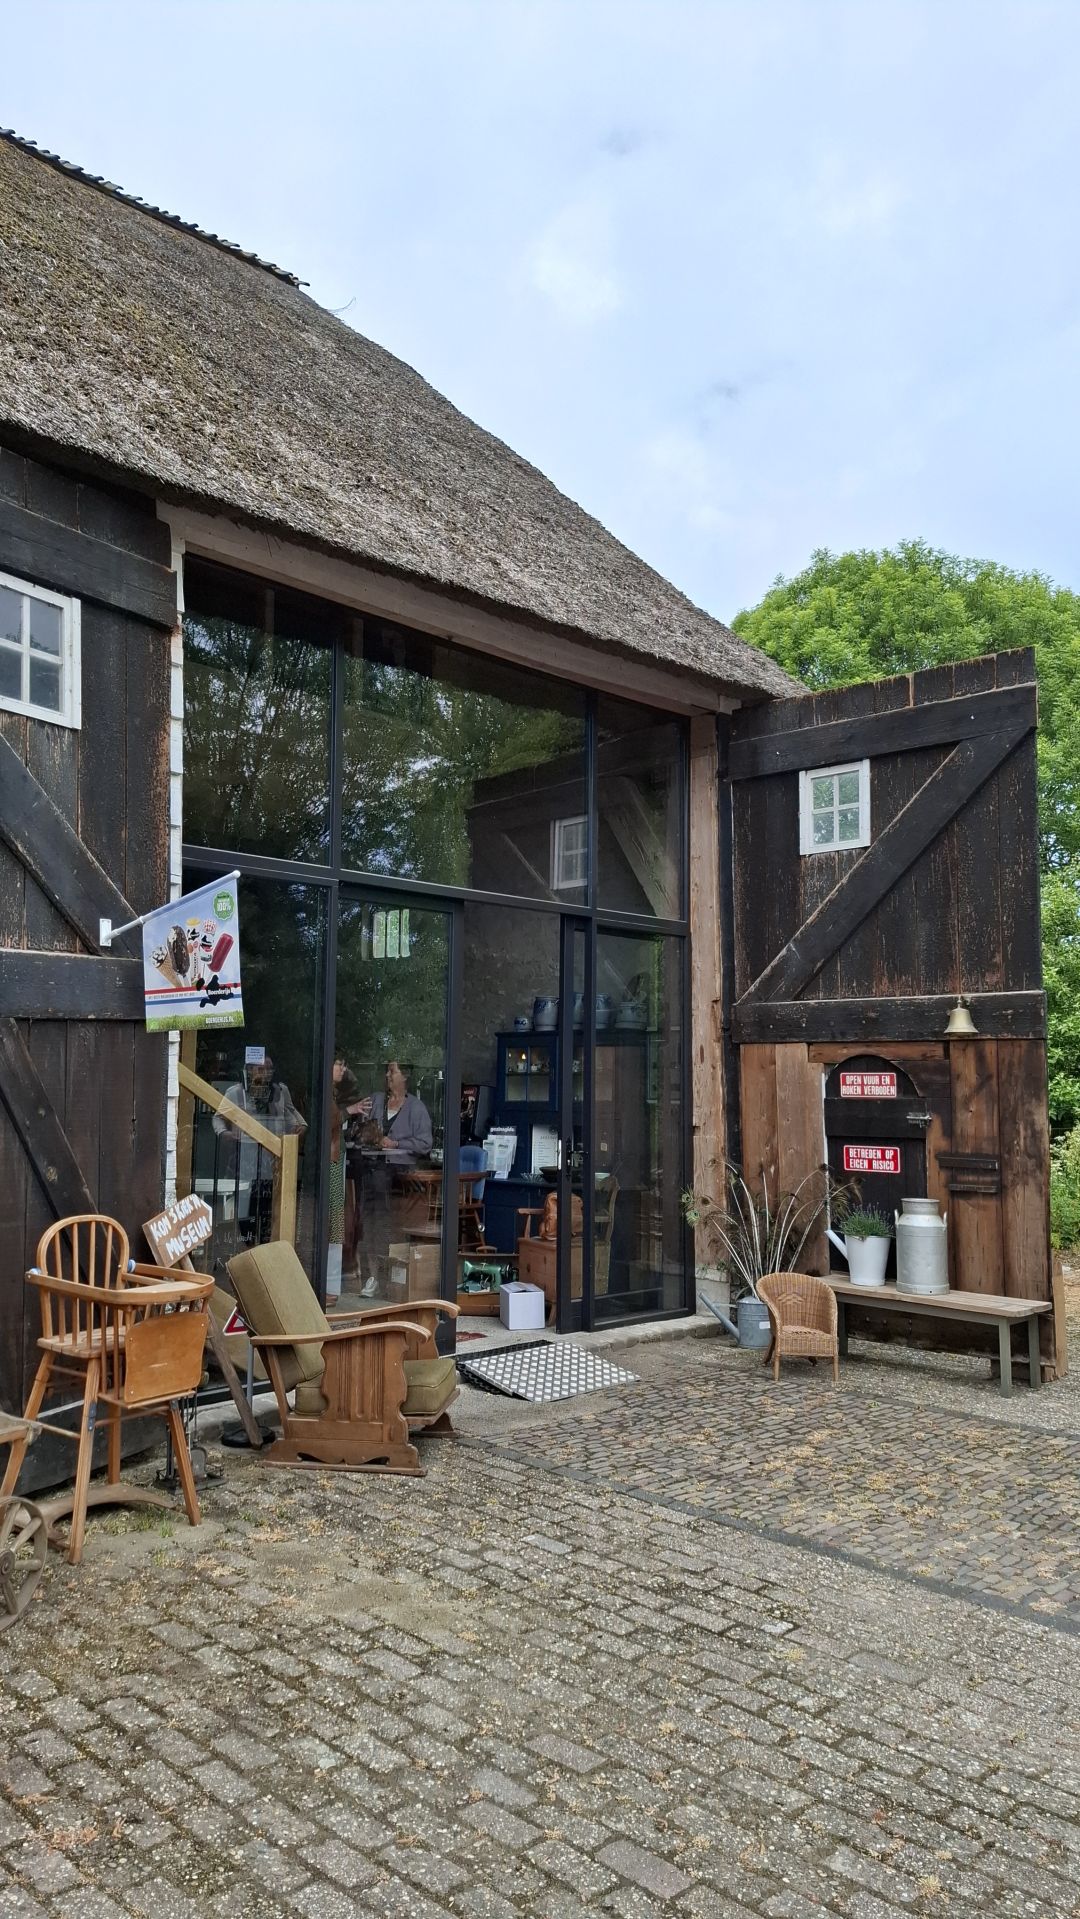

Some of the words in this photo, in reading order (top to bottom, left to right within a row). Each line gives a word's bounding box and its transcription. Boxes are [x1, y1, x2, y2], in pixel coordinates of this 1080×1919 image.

[845, 1075, 862, 1085] OPEN
[863, 1075, 880, 1085] VUUR
[881, 1075, 891, 1085] EN
[842, 1085, 862, 1095] ROKEN
[863, 1085, 895, 1096] VERBODEN
[849, 1148, 882, 1160] BETREDEN
[885, 1149, 894, 1160] OP
[849, 1159, 869, 1169] EIGEN
[872, 1160, 895, 1171] RISICO
[165, 1215, 211, 1261] MUSEUM
